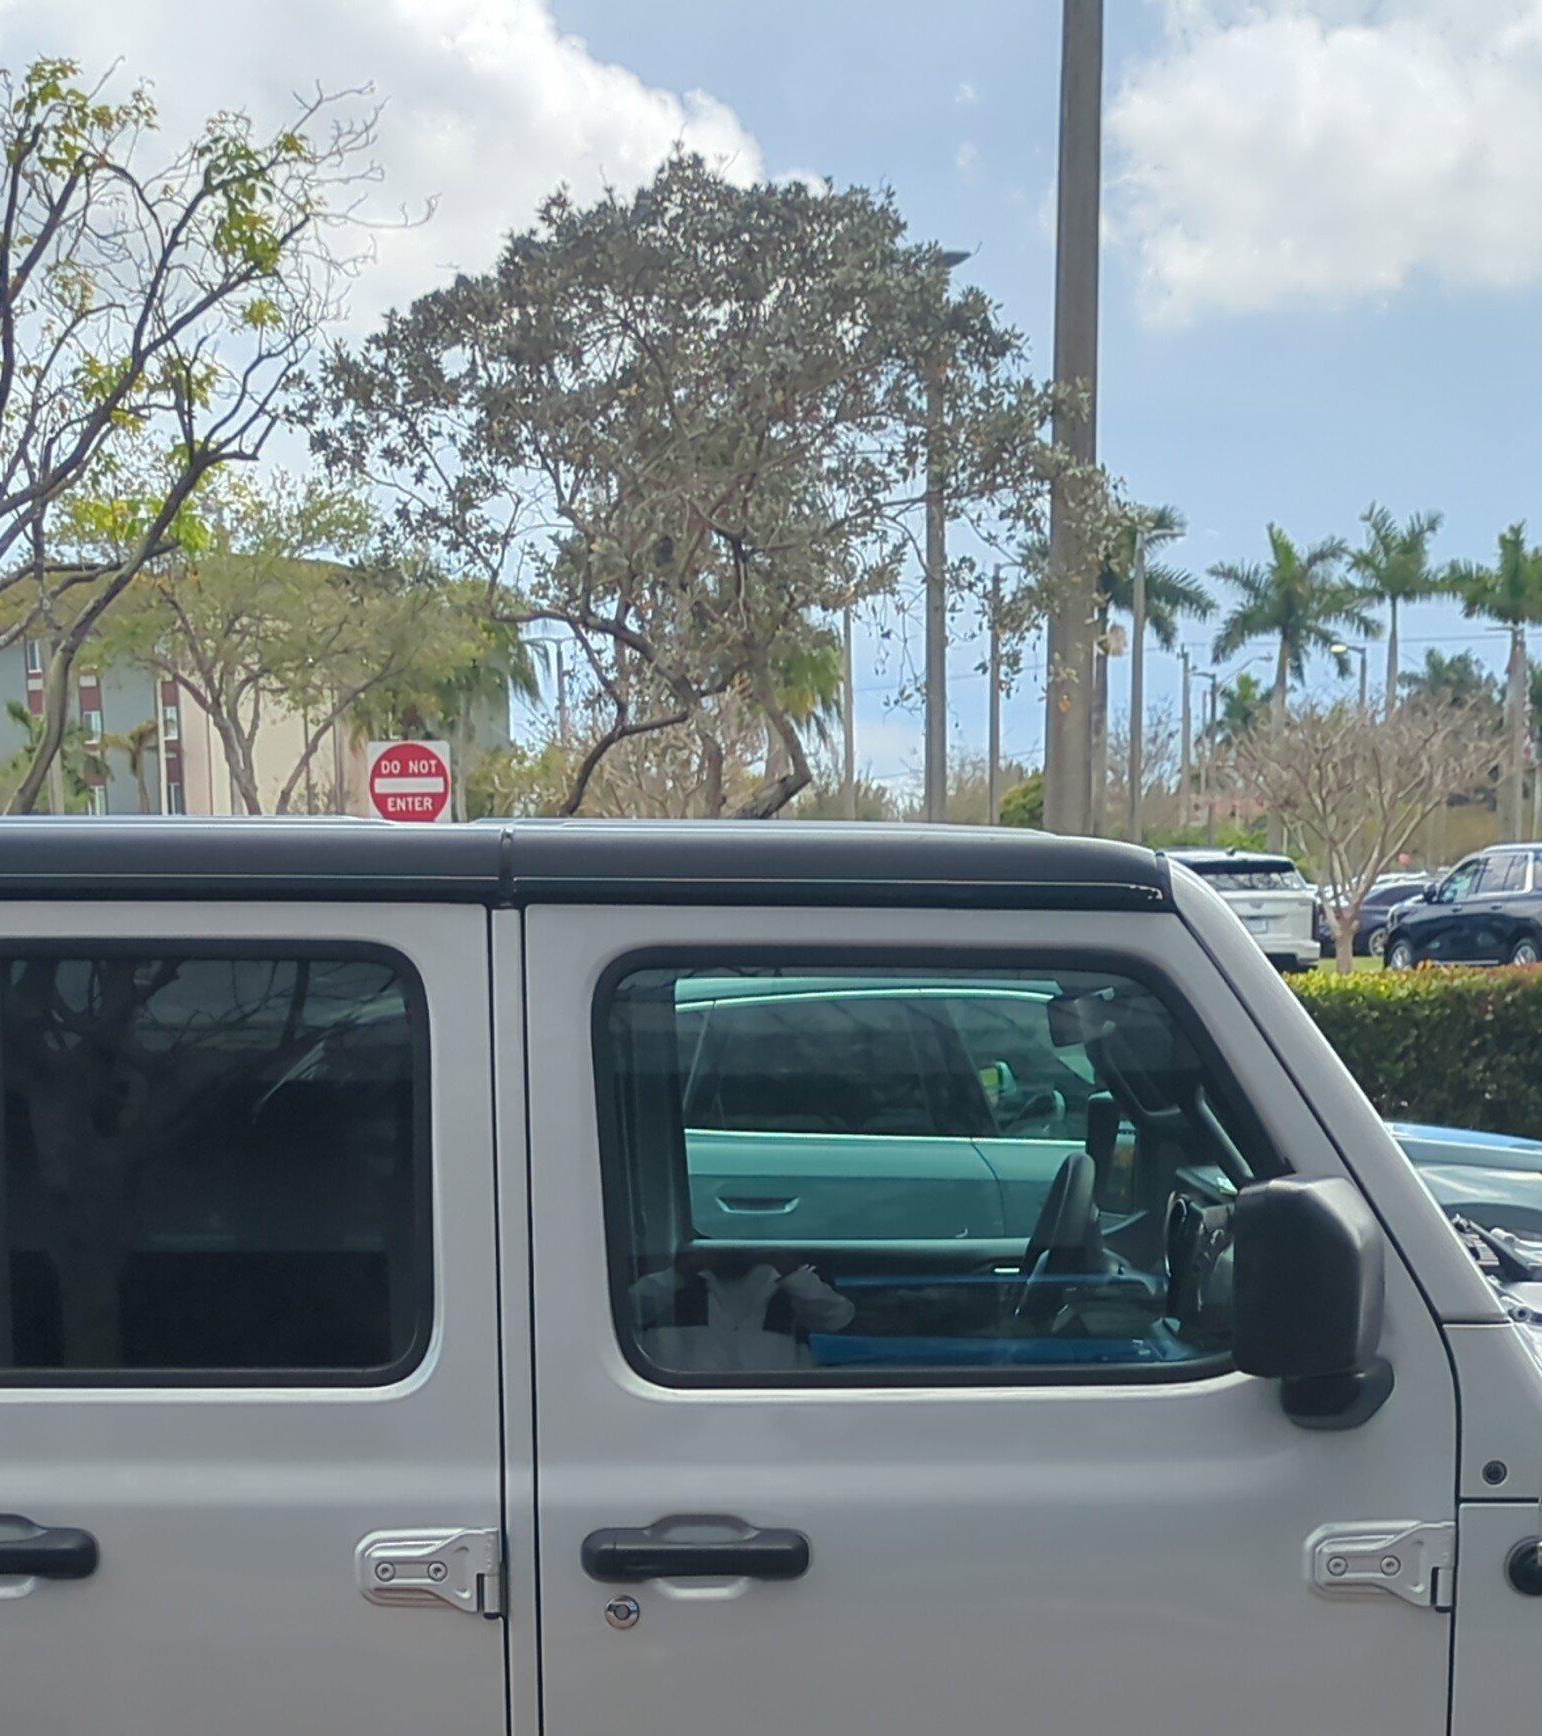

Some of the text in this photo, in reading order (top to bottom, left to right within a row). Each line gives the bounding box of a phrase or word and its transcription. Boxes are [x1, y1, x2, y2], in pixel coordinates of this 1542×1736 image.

[380, 759, 438, 775] DO NOT
[387, 796, 433, 812] ENTER
